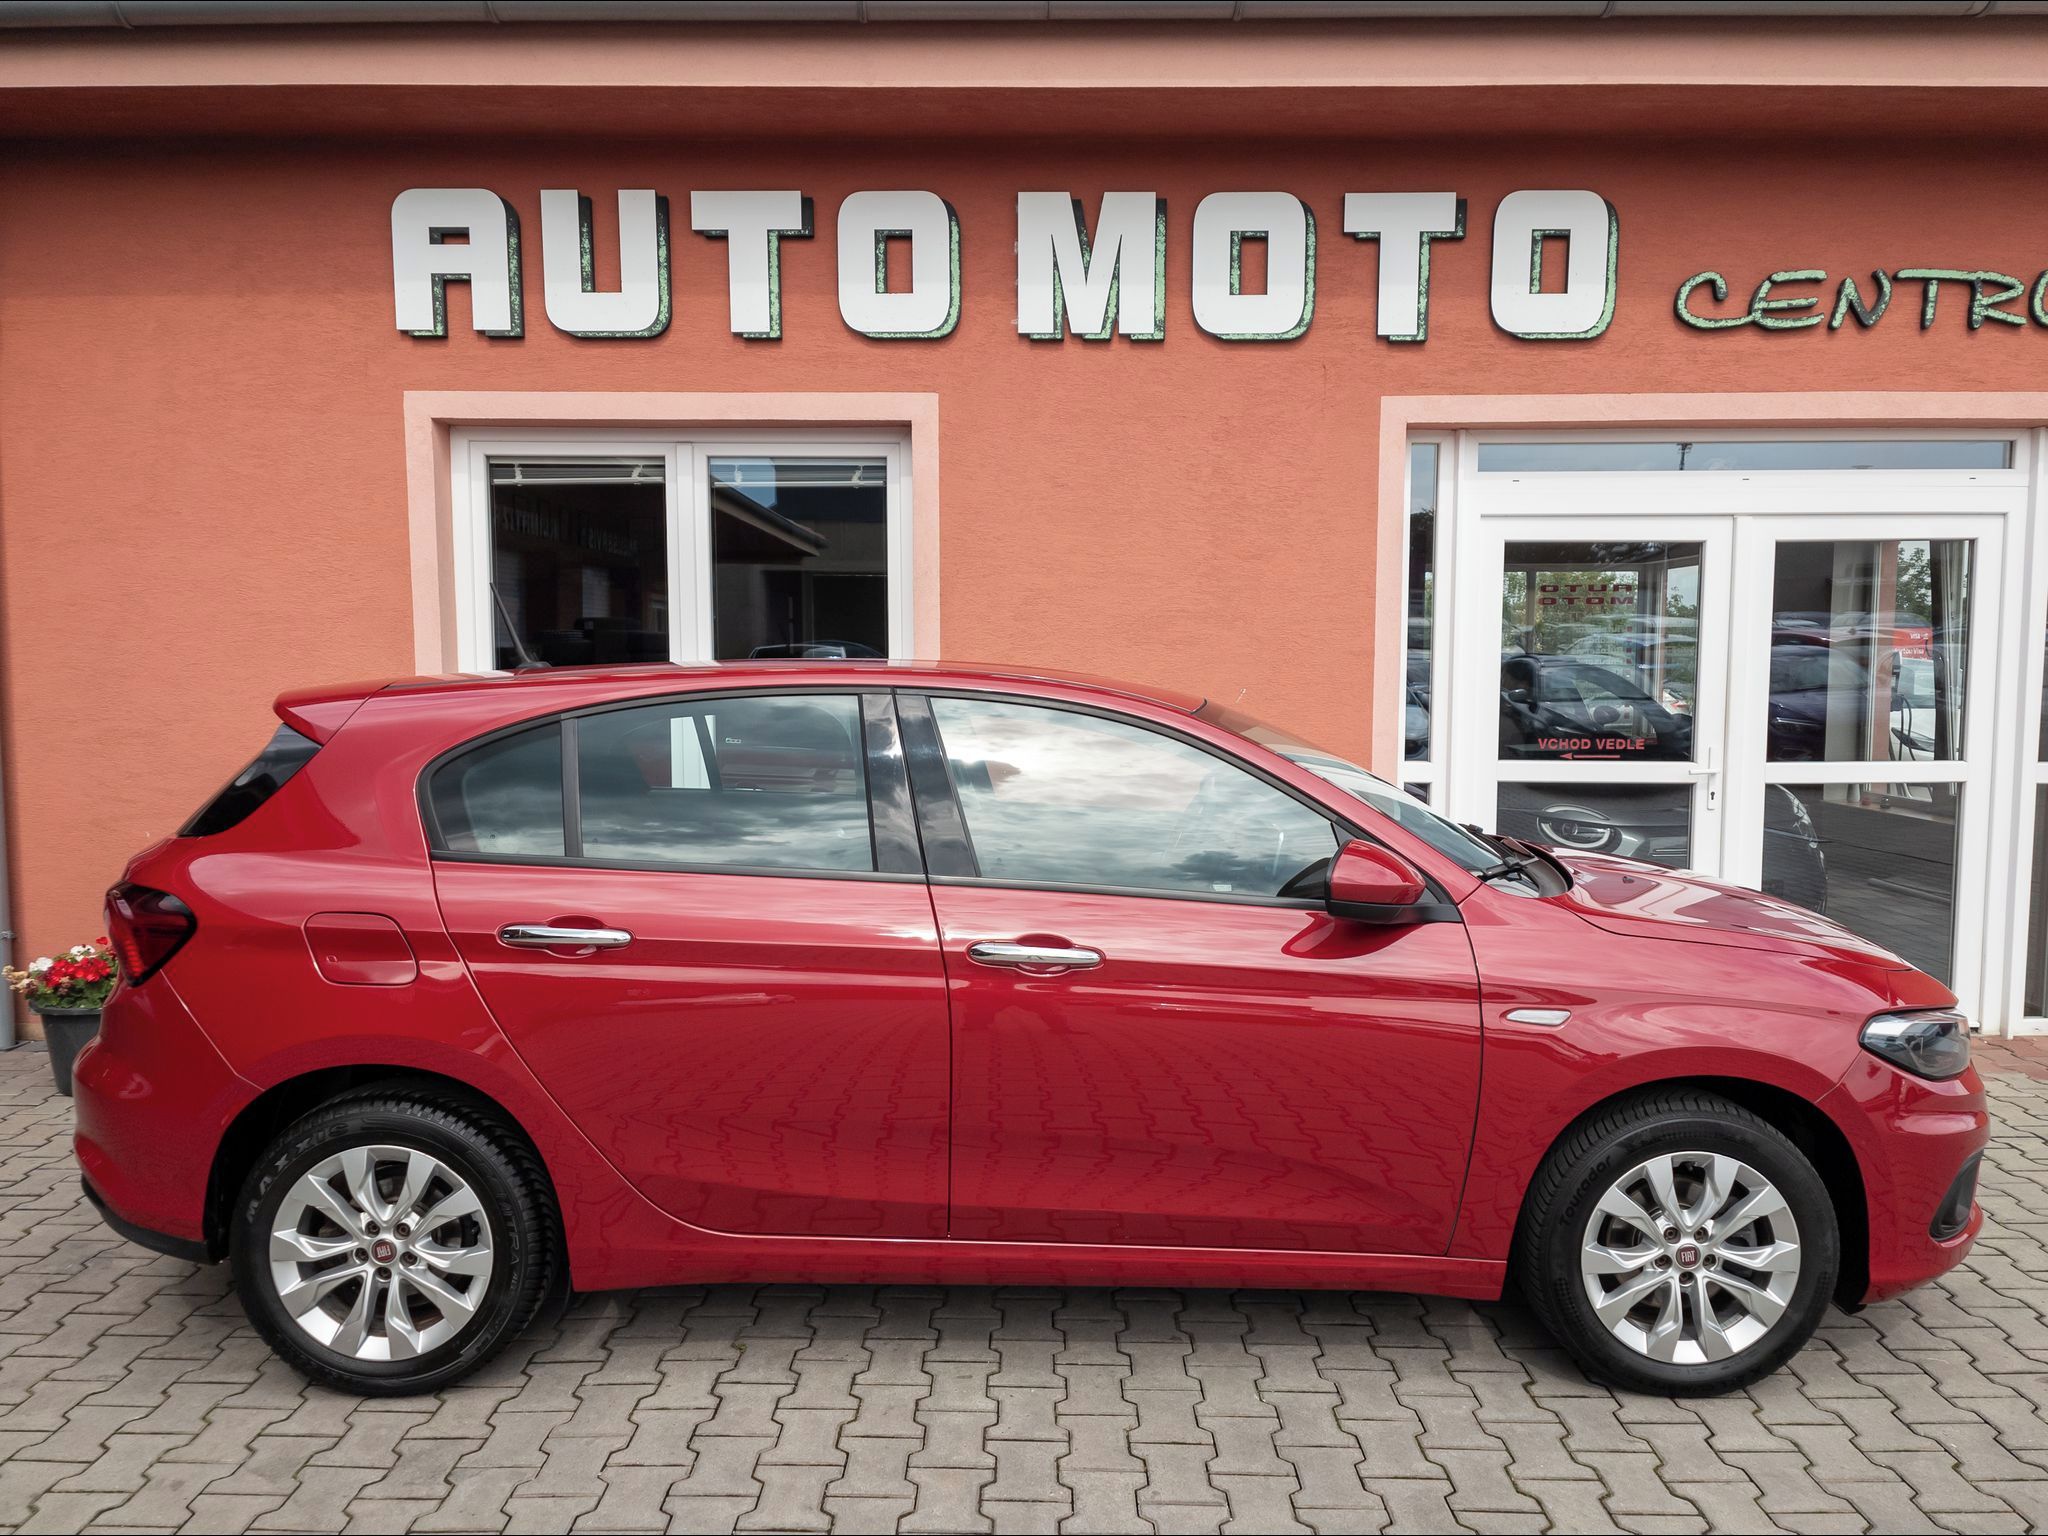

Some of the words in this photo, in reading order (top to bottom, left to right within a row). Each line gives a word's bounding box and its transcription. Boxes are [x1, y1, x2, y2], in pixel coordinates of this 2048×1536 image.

[391, 188, 960, 339] AUTO
[1017, 190, 1619, 342] MOTO
[1538, 738, 1592, 750] VCHOD
[1596, 738, 1645, 750] VEDLE
[1560, 1155, 1612, 1227] Tourador
[1680, 1250, 1696, 1263] FIAT
